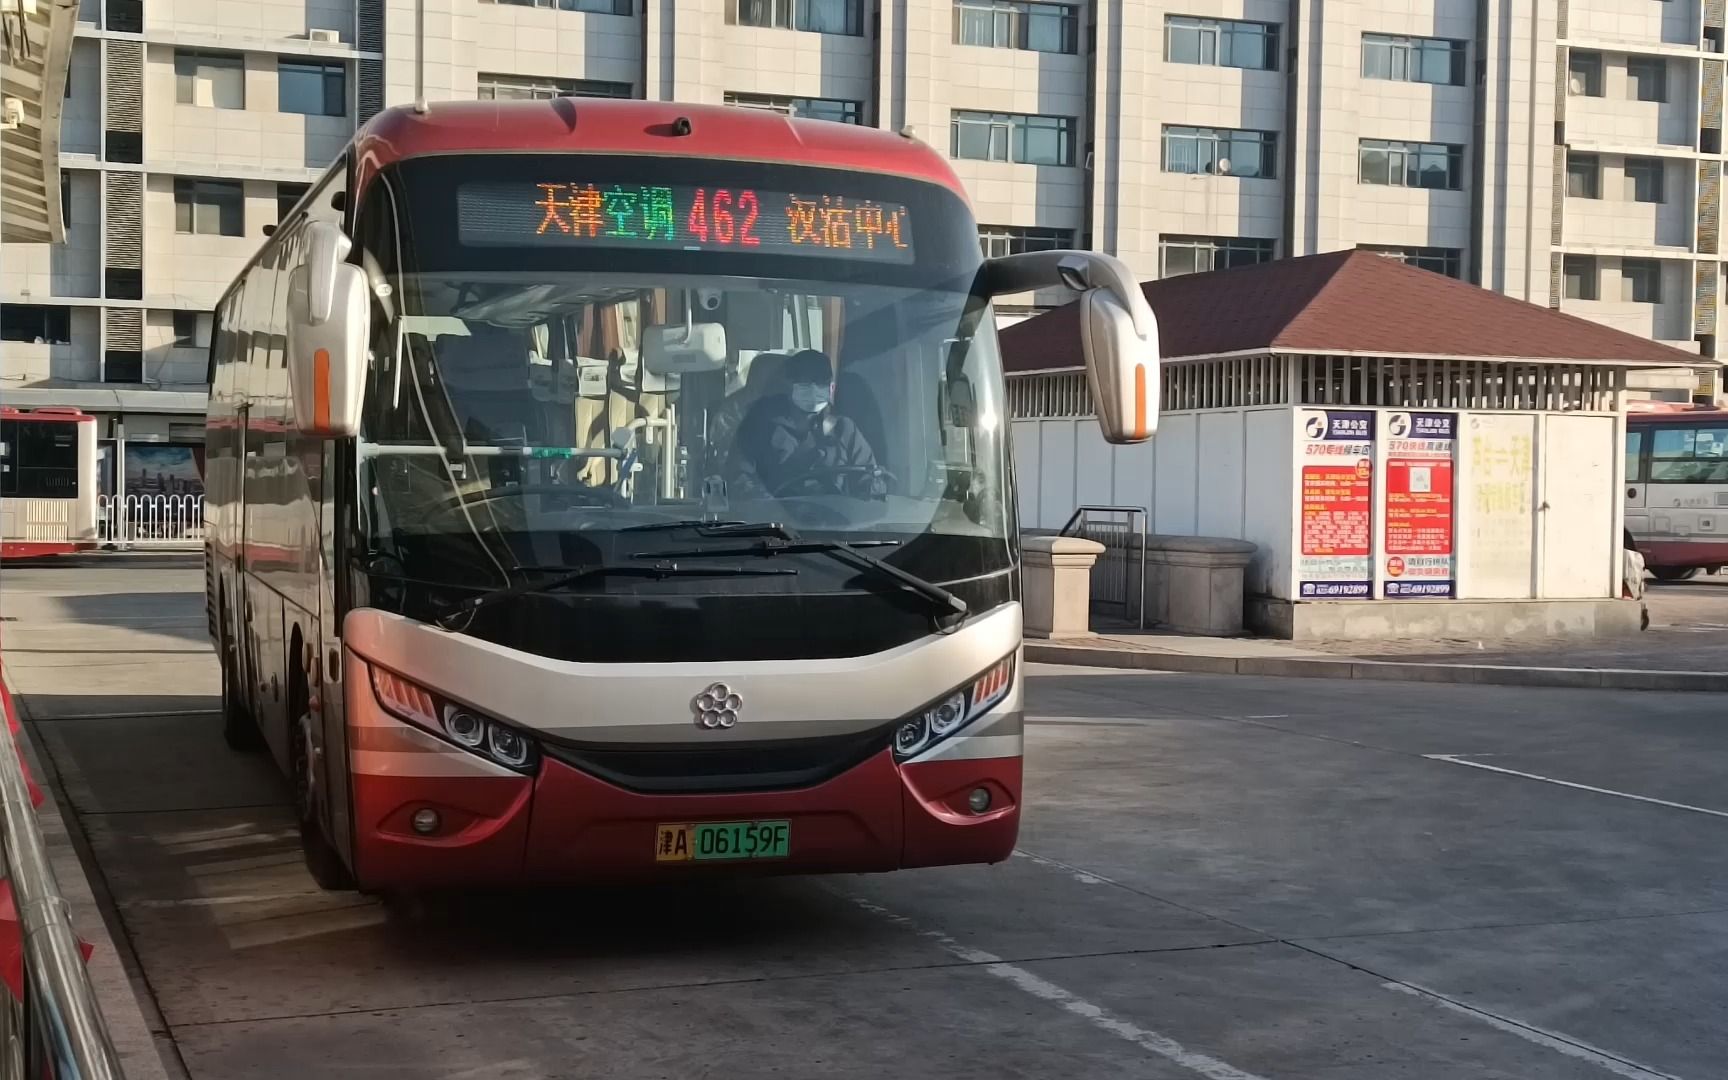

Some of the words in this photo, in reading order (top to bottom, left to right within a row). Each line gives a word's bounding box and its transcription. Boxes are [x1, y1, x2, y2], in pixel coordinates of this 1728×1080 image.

[535, 182, 674, 240] 天津空调
[686, 188, 760, 246] 462
[1332, 419, 1368, 430] 天津公交
[1415, 417, 1451, 428] 天津公交
[658, 829, 688, 855] 津A
[700, 825, 787, 854] 06159F
